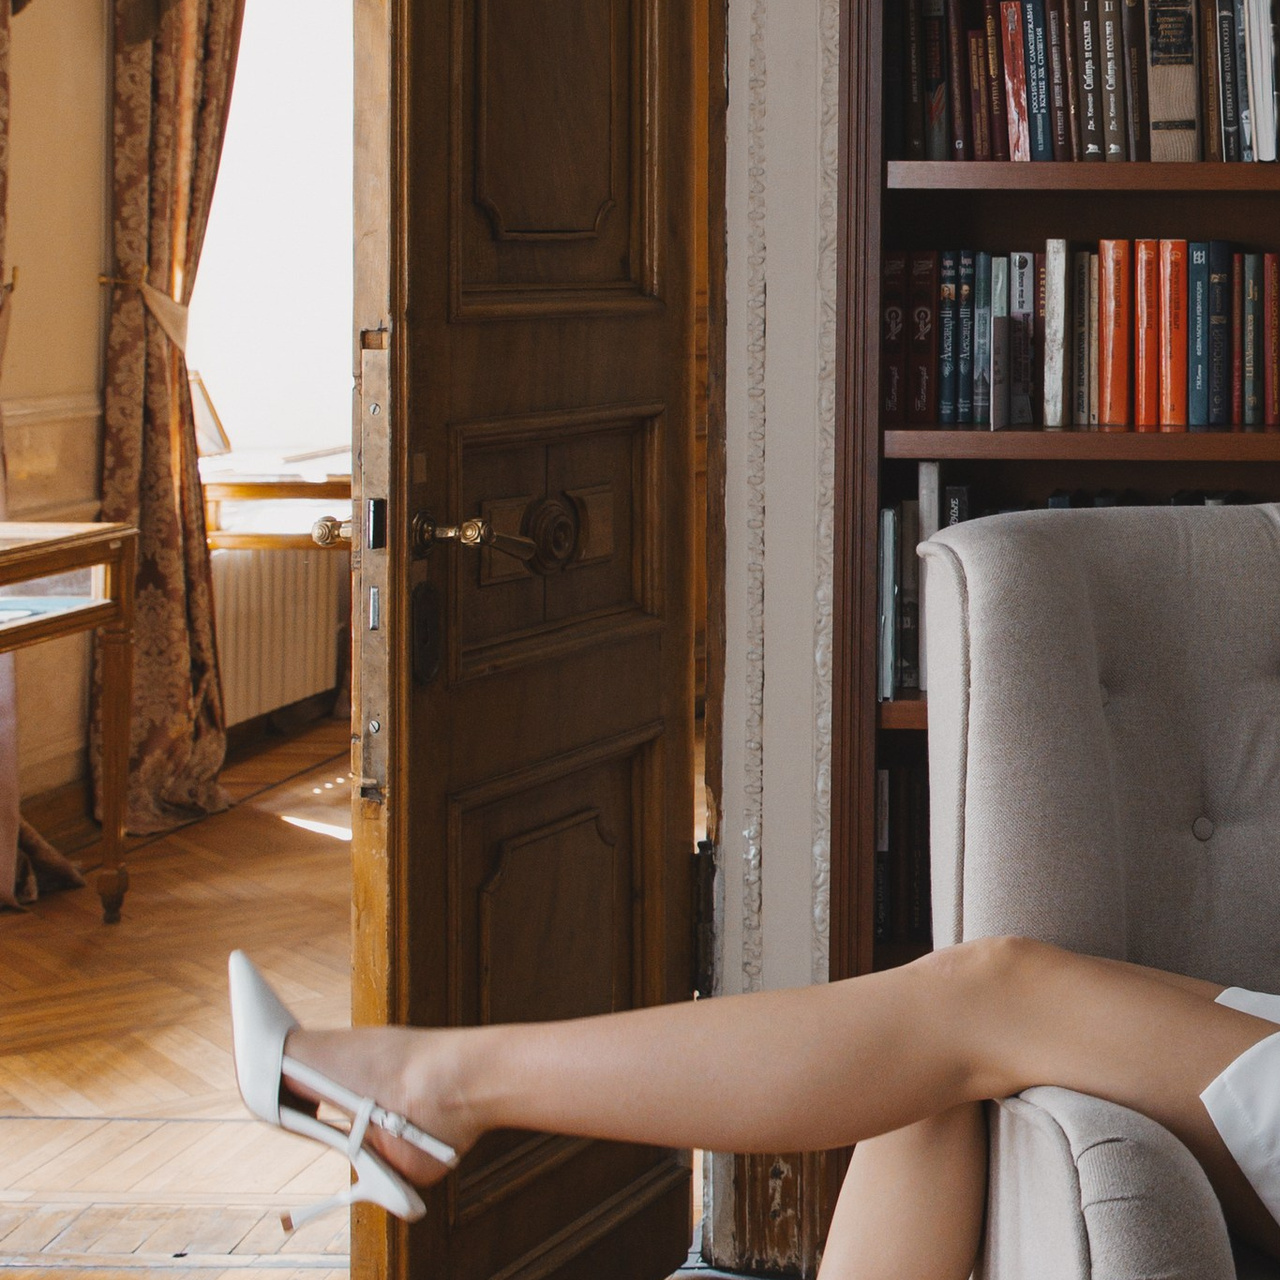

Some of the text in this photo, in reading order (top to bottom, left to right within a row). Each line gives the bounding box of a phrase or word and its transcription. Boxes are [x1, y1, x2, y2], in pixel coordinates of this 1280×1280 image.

[1082, 19, 1092, 51] ссылка
[1105, 20, 1114, 51] ссылка
[1082, 59, 1095, 91] Сибирь
[1104, 59, 1117, 91] Сибирь
[940, 318, 954, 362] Александр
[960, 318, 976, 360] Александр
